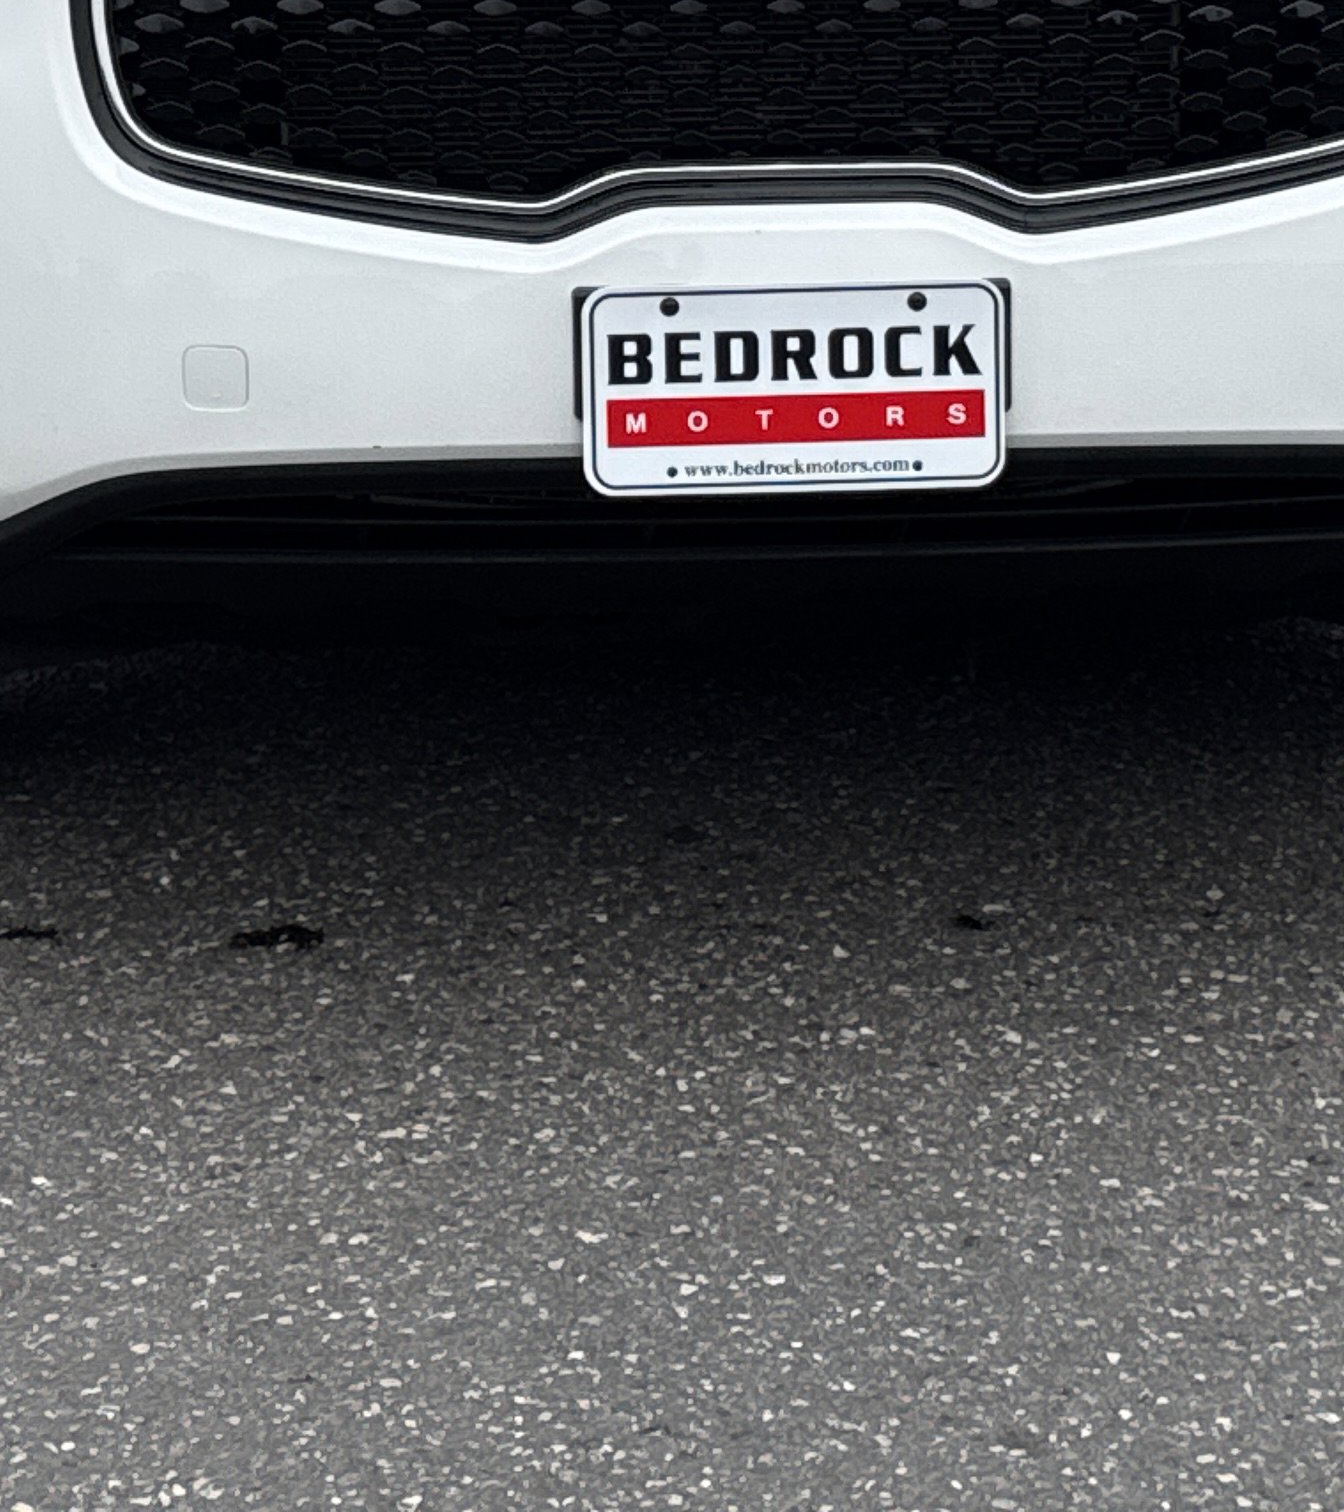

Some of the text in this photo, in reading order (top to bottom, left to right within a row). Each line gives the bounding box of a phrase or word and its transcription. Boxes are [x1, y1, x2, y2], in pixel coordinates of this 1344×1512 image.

[607, 324, 982, 385] BEDROCK
[625, 403, 967, 434] MOTORS
[685, 459, 910, 477] www.bedrockmotors.com
